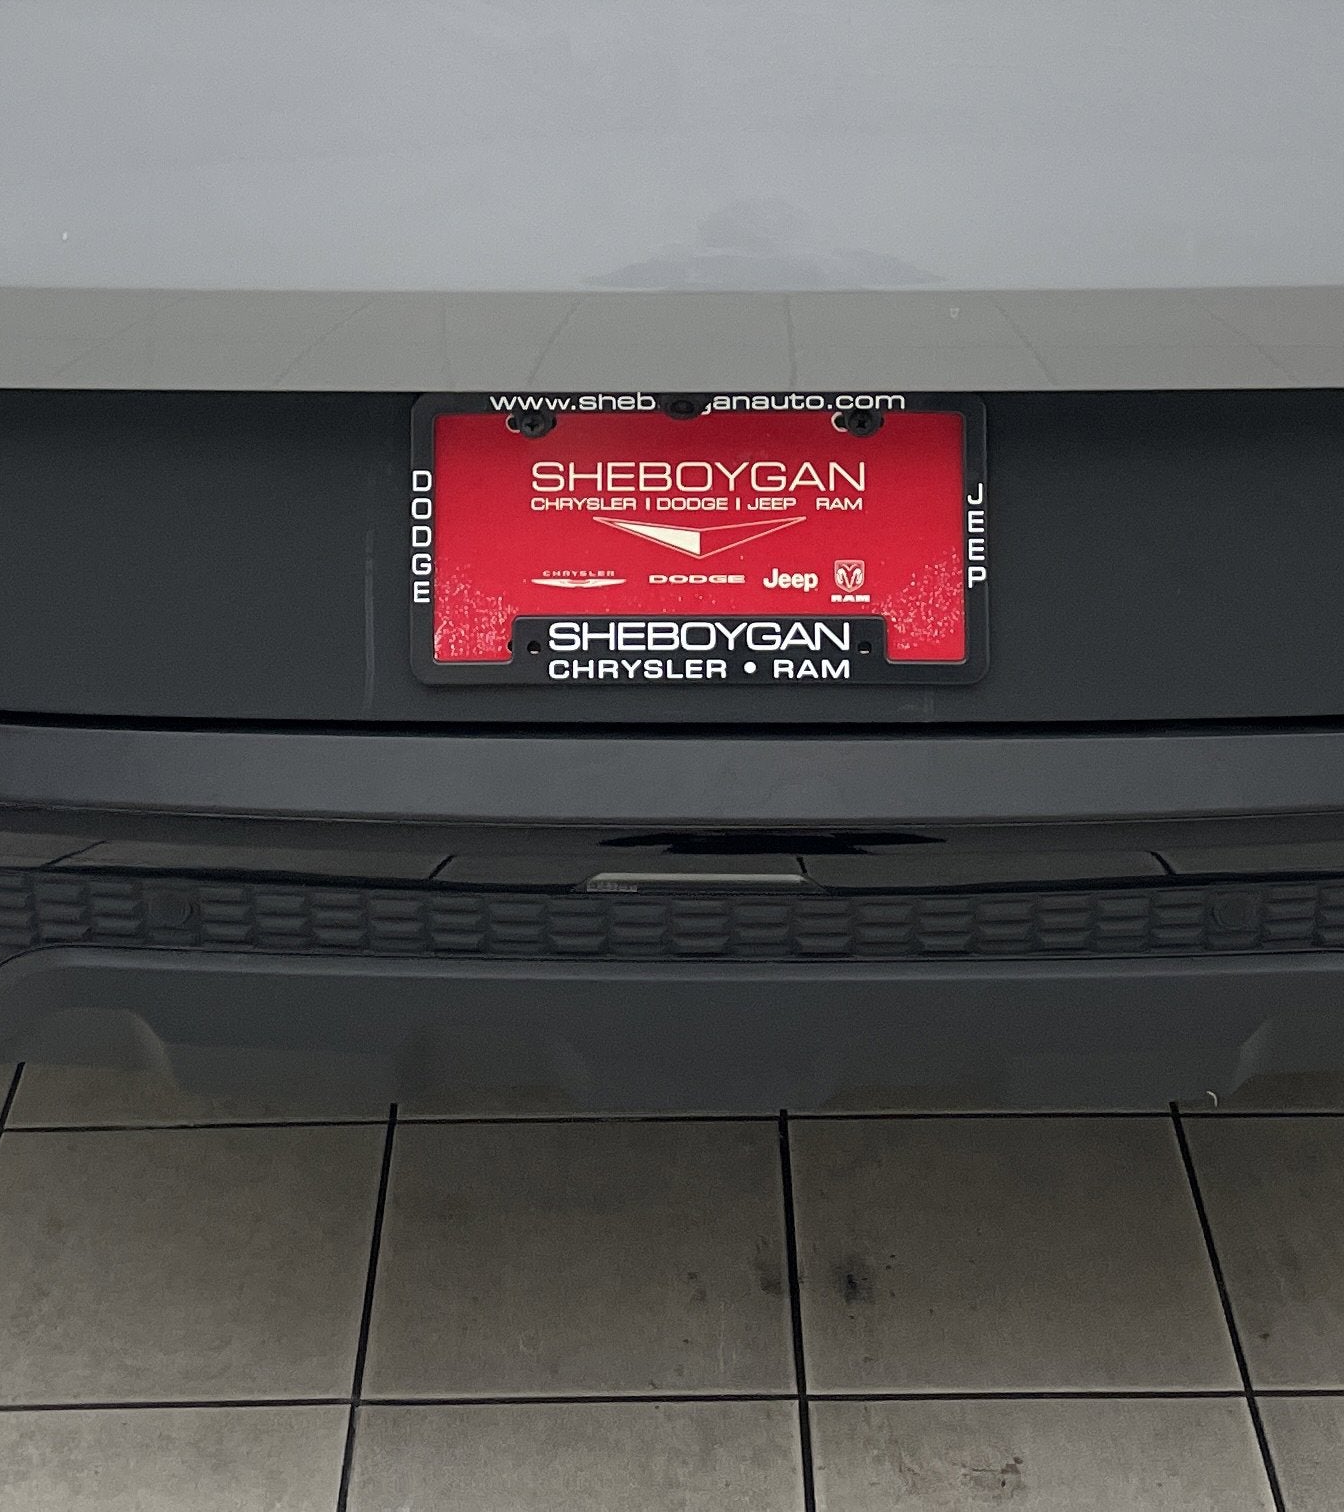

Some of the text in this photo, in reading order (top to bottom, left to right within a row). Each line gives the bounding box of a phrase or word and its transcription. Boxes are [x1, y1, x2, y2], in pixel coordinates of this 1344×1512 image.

[489, 391, 906, 416] www.shebanauto.com
[531, 460, 866, 492] SHEBOYGAN
[530, 496, 863, 511] CHRYSLER DODGE JEEP RAM
[410, 469, 433, 604] DODGE
[966, 482, 987, 589] JEEP
[542, 569, 616, 577] CHRYSLER
[648, 574, 746, 585] DODGE
[762, 567, 819, 592] Jeep
[830, 593, 871, 603] RAM
[548, 621, 851, 652] SHEBOYGAN
[548, 659, 851, 680] CHRYSLER RAM
